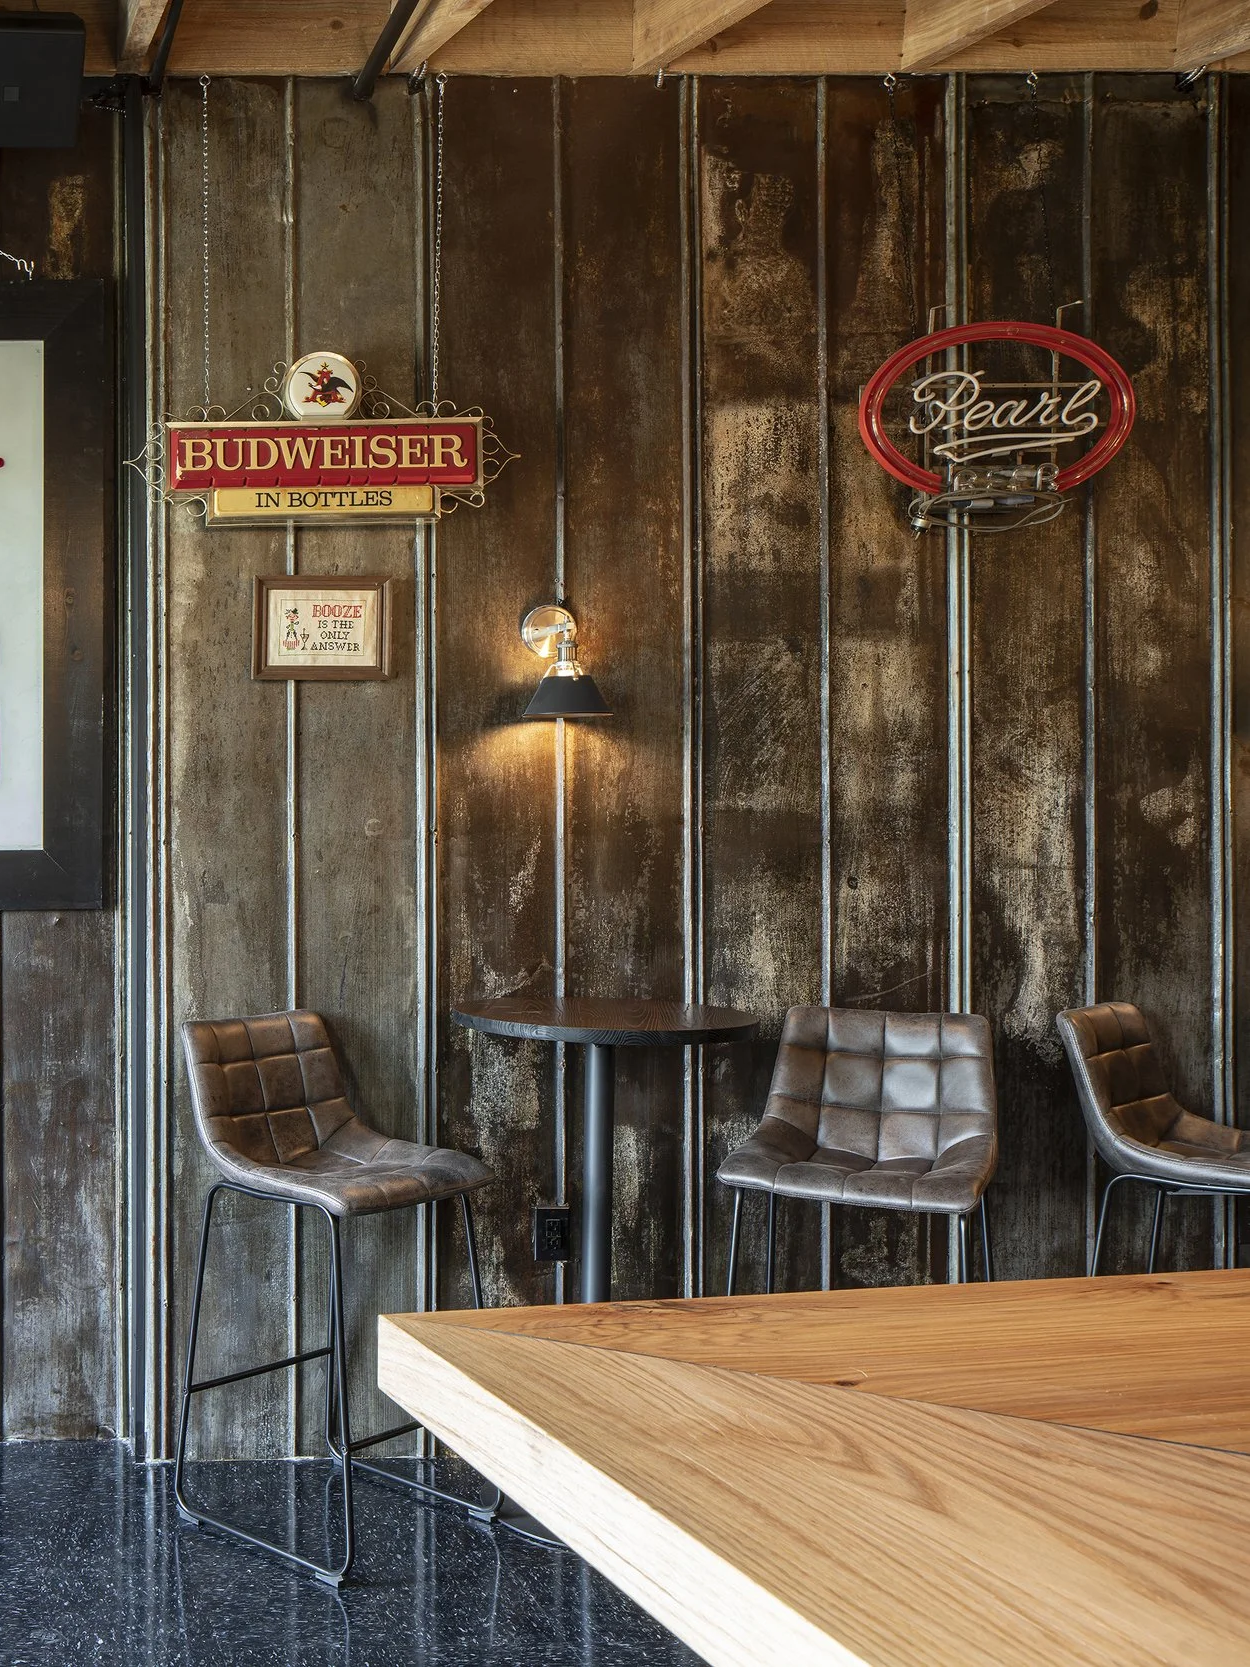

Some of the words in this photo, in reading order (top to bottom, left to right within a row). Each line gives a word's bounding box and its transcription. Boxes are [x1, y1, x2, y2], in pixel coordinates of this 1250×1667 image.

[909, 369, 1102, 436] Pearl
[179, 434, 468, 472] BUDWEISER
[255, 491, 281, 508] IN
[287, 490, 393, 508] BOTTLES
[311, 604, 362, 619] BOOZE
[317, 620, 328, 629] IS
[331, 620, 355, 629] THE
[320, 630, 351, 640] ONLY
[310, 641, 361, 652] ANSWER
